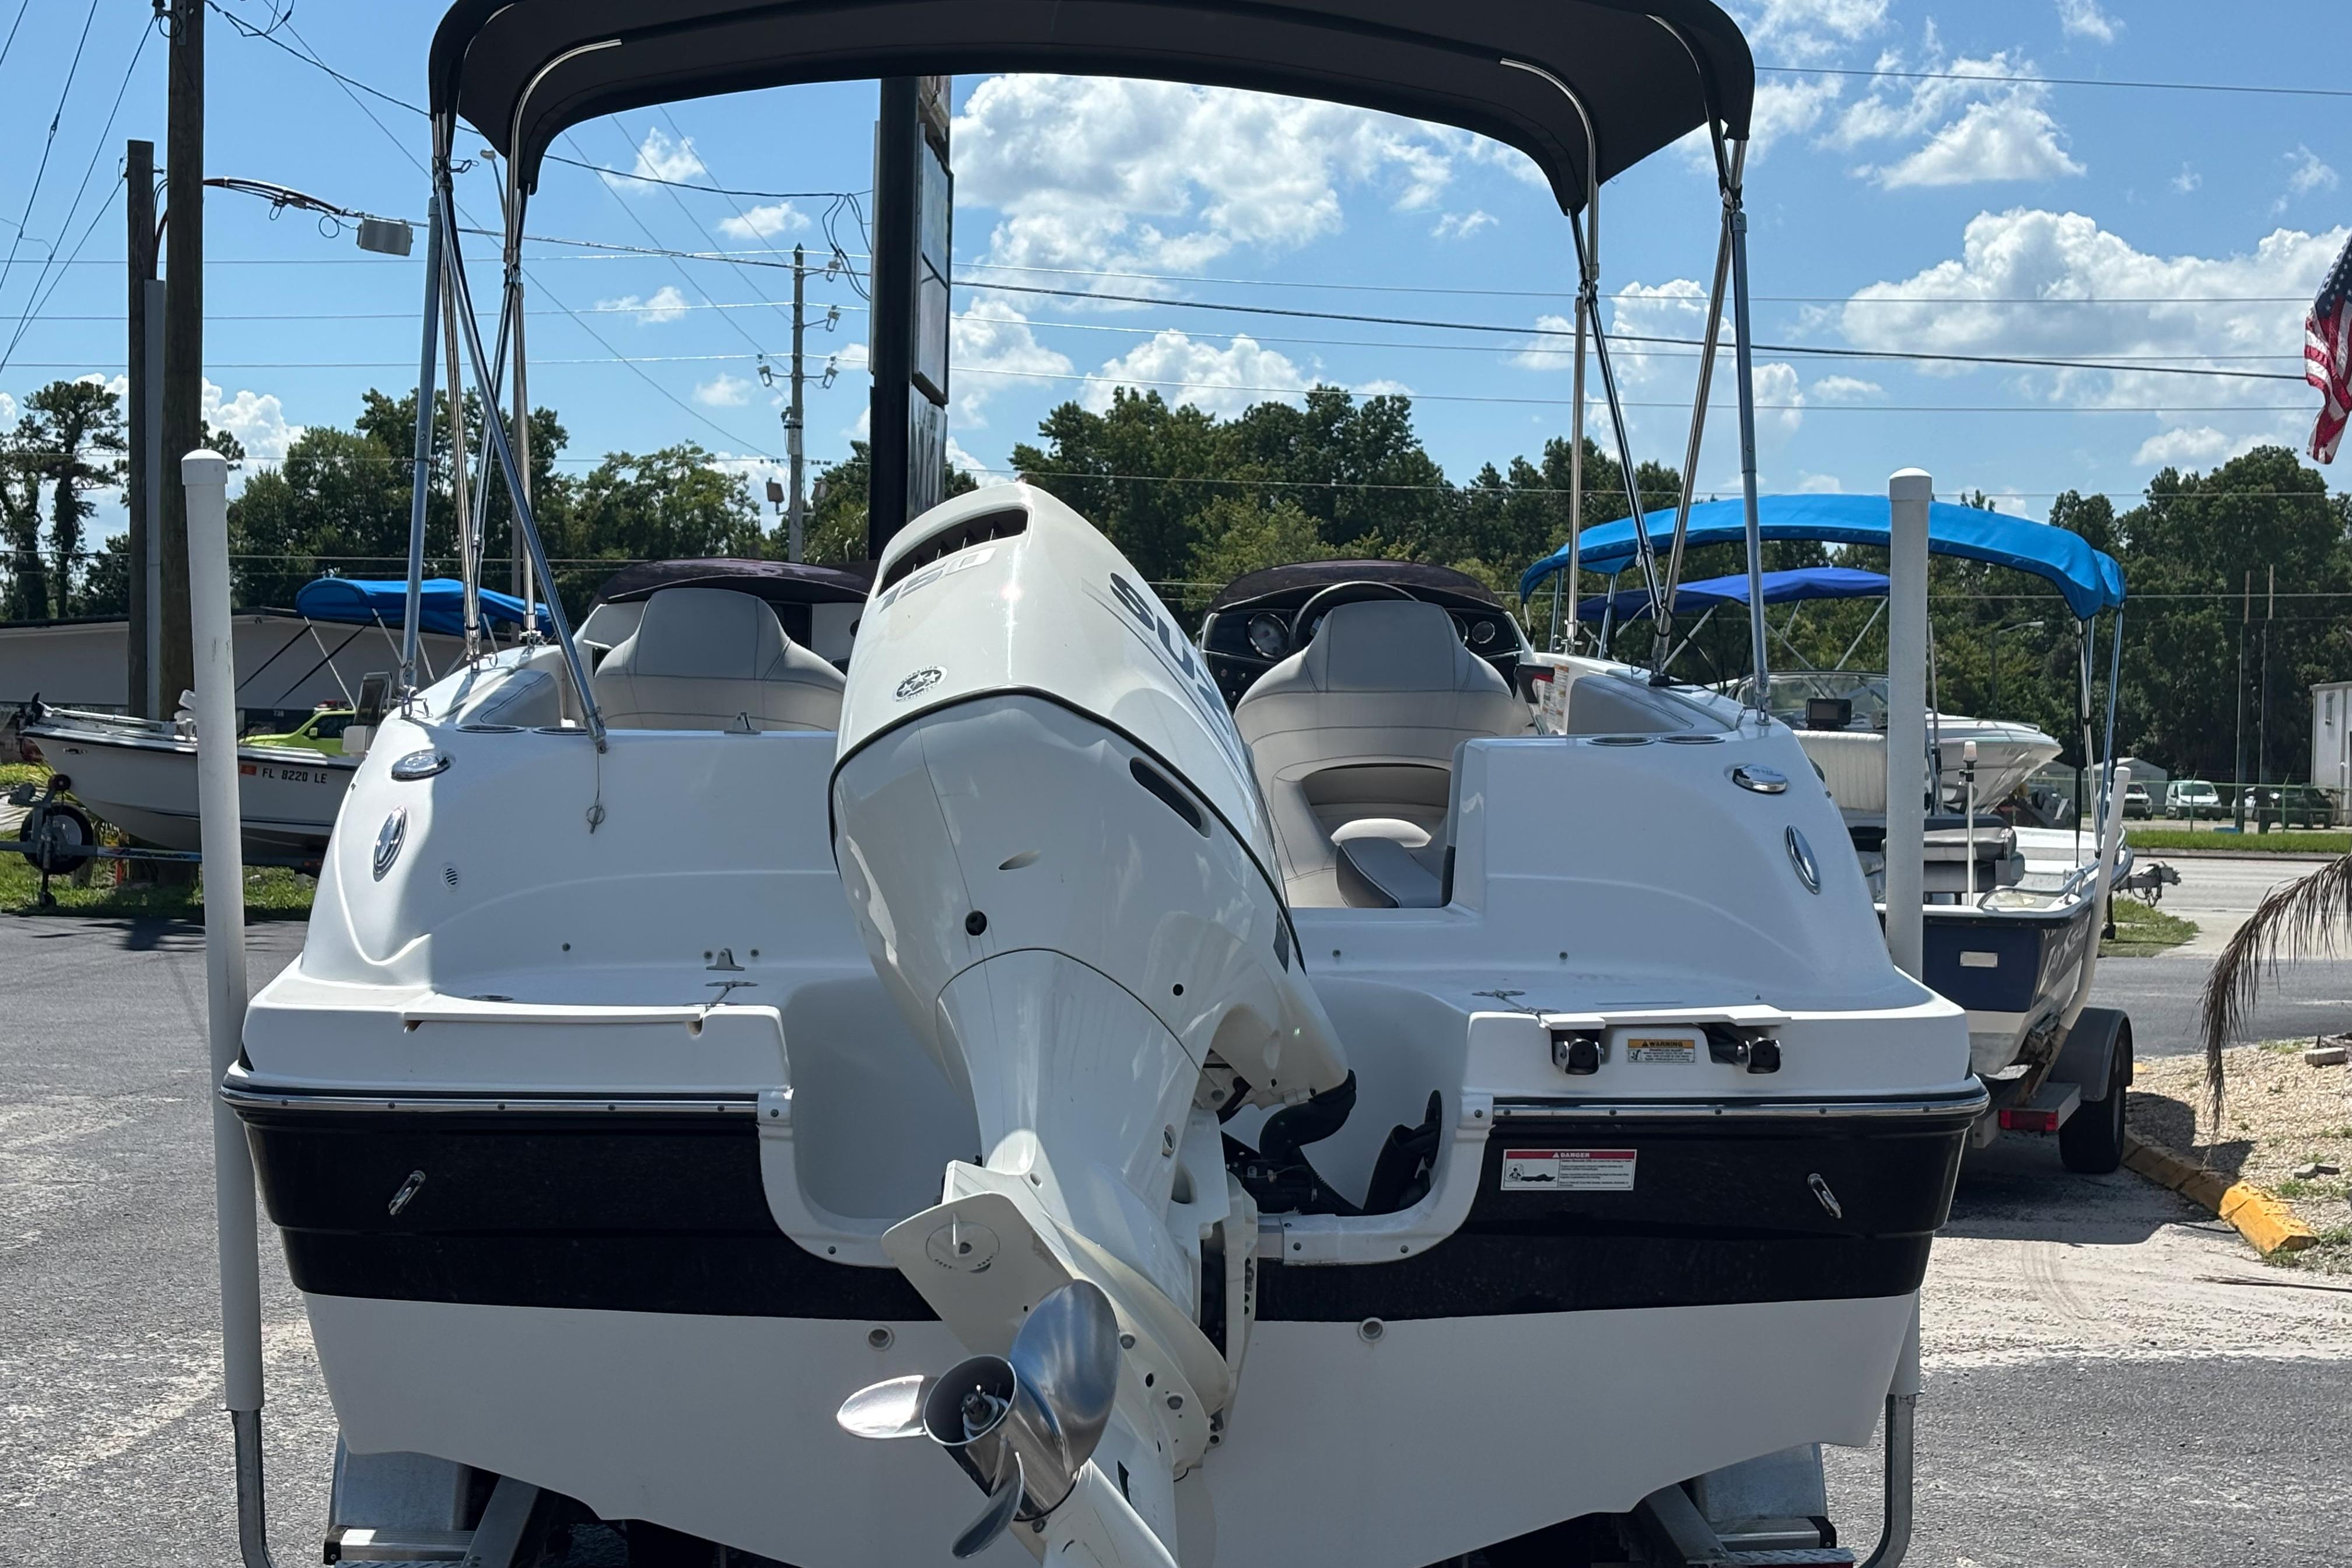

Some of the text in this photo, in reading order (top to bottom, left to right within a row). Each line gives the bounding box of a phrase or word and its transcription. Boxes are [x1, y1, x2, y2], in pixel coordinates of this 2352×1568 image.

[878, 546, 997, 614] 150
[262, 768, 327, 785] FL 8220 LE
